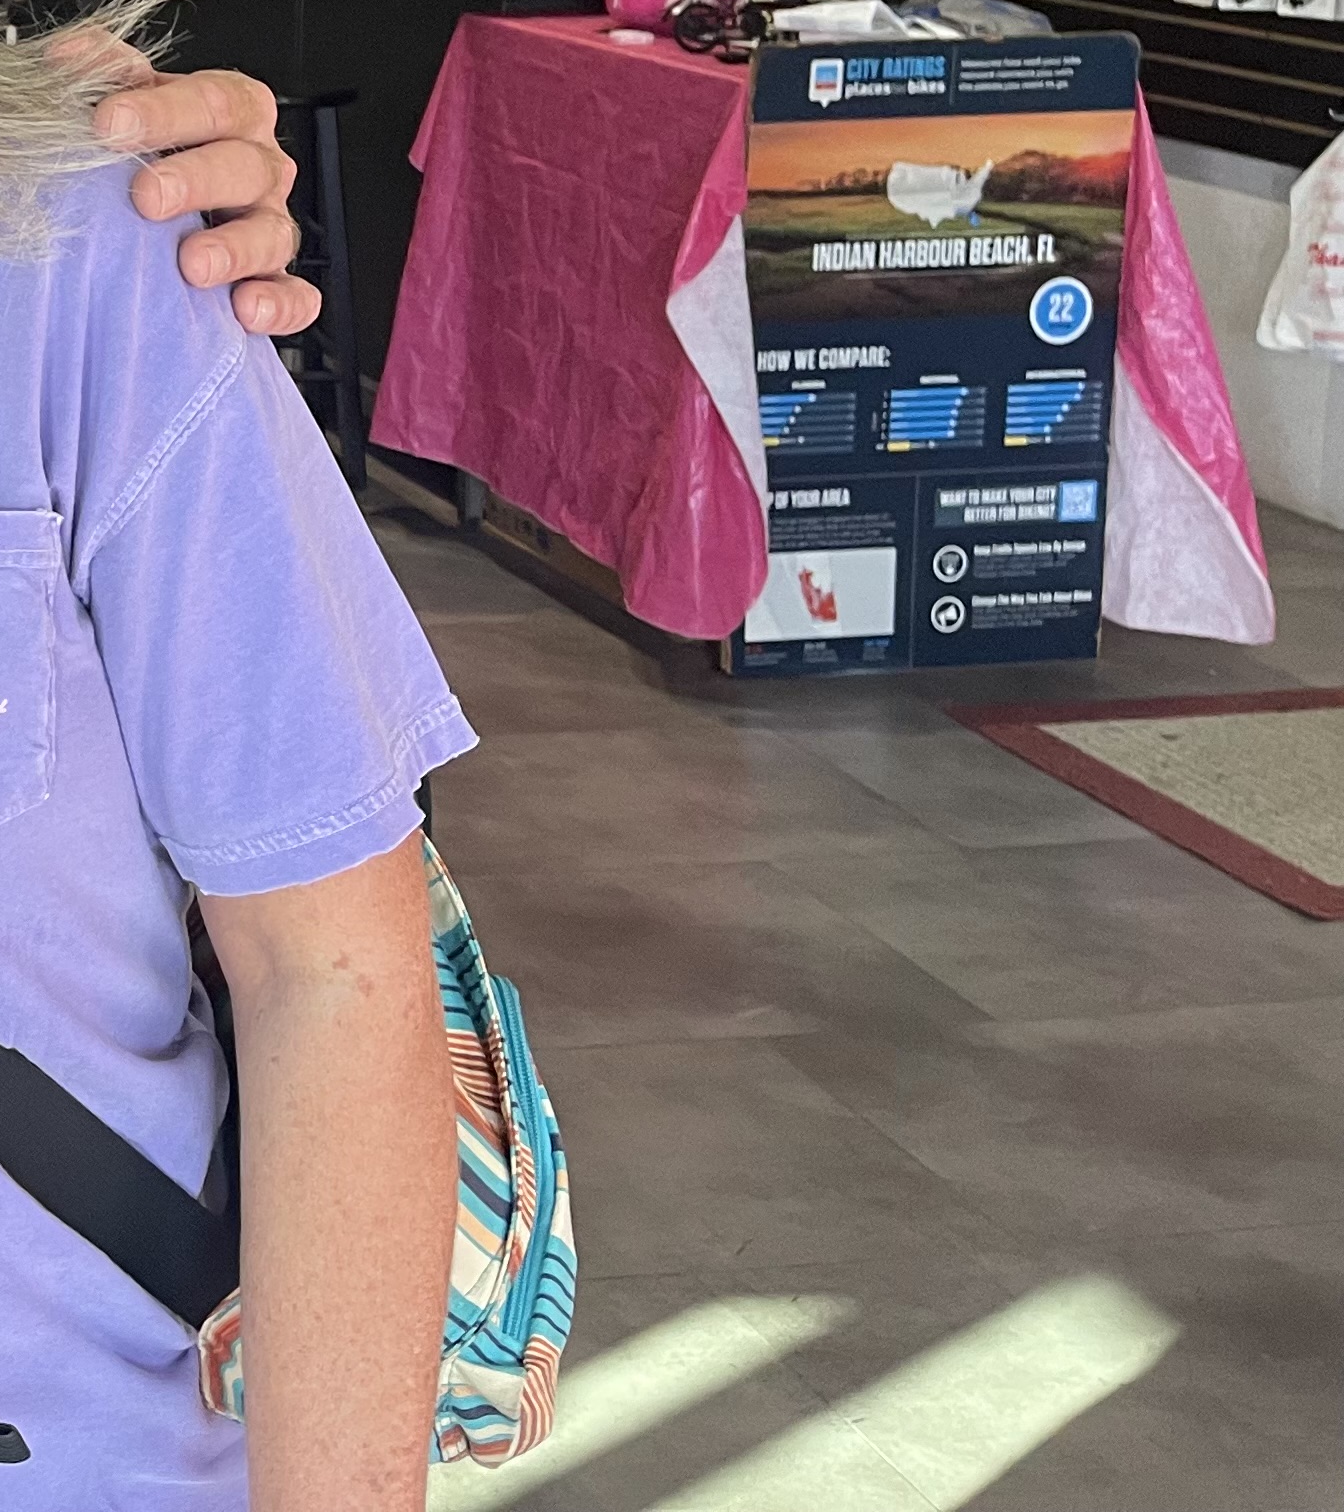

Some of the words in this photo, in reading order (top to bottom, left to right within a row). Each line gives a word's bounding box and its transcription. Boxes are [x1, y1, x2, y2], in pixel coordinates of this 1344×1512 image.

[846, 58, 880, 80] CITY
[813, 241, 876, 272] INDIAN
[879, 238, 966, 269] HARBOUR
[1037, 234, 1056, 263] FL
[1049, 293, 1073, 323] 22
[795, 349, 816, 370] WE
